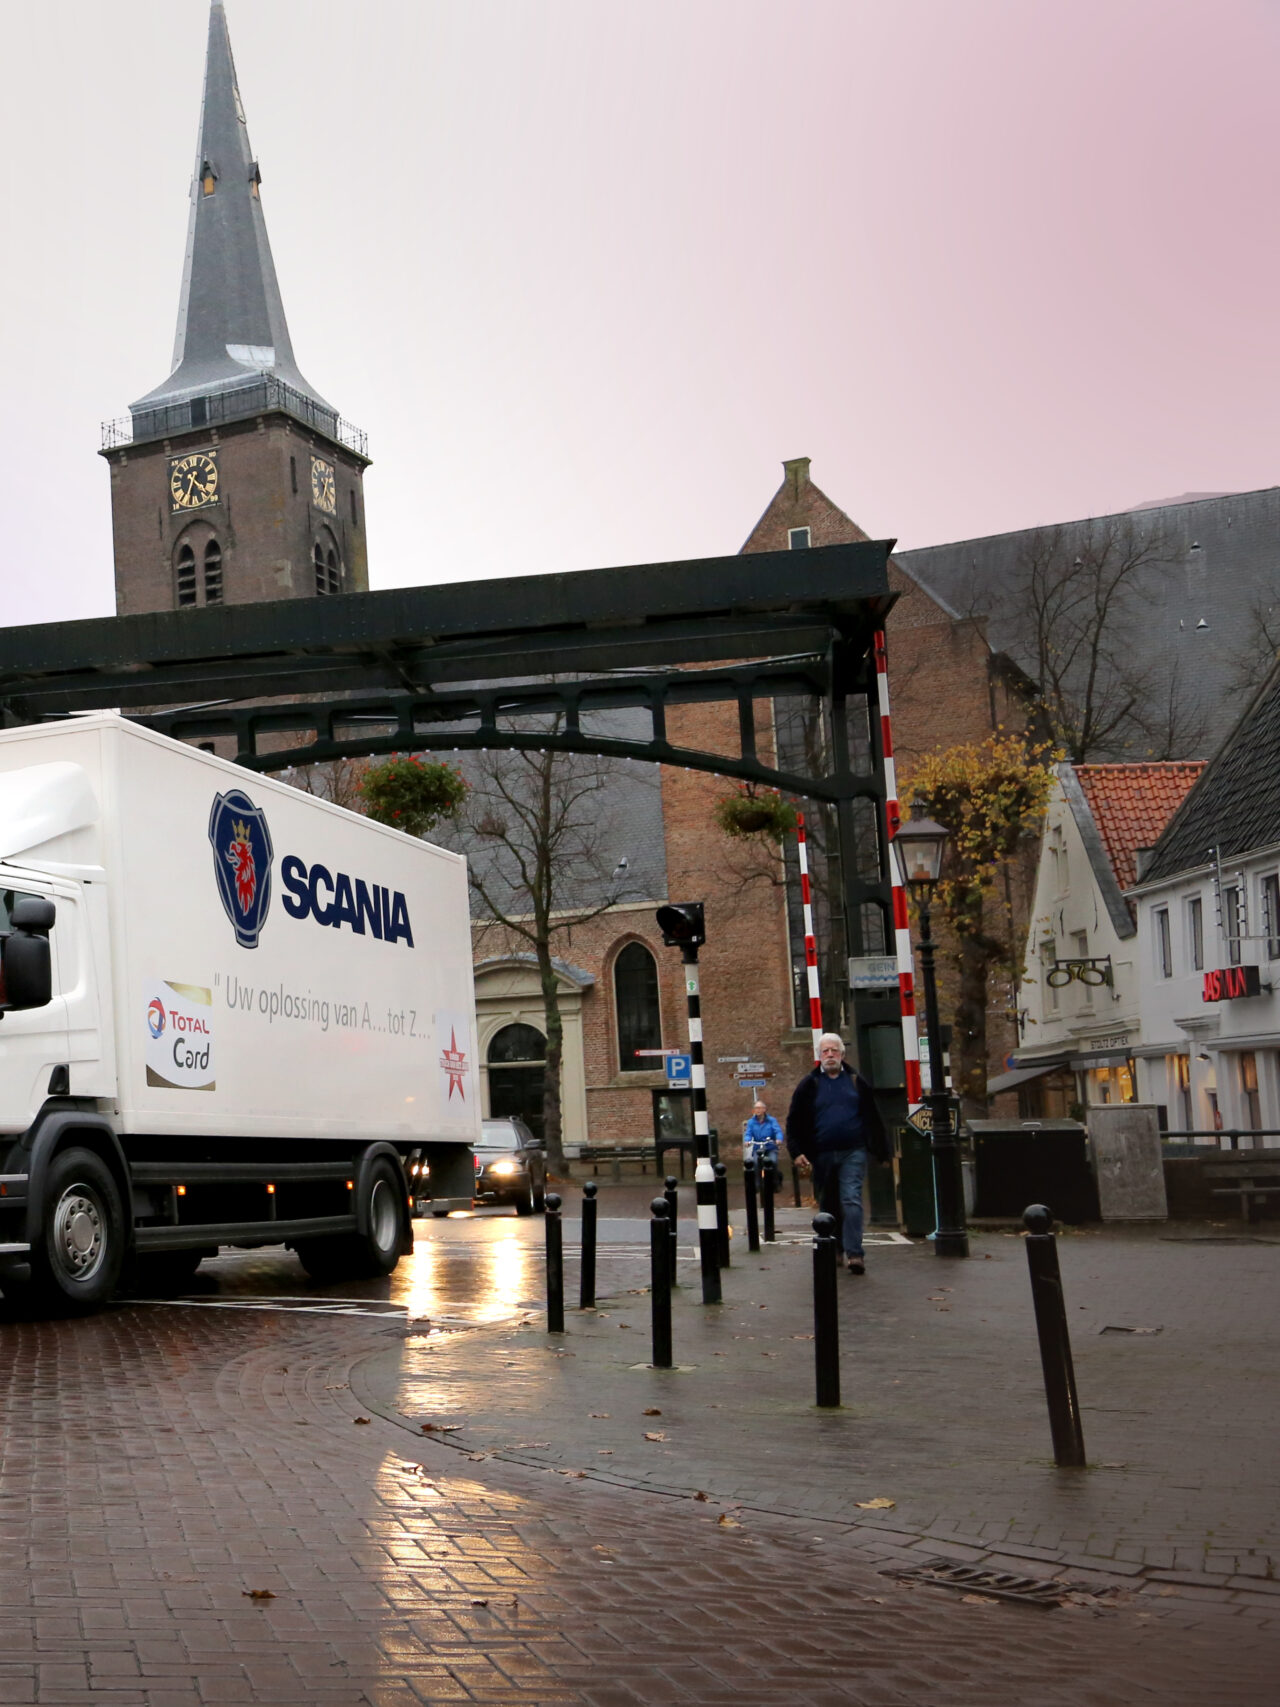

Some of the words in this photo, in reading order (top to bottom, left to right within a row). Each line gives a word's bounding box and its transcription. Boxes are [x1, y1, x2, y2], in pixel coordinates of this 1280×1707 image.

[281, 855, 415, 949] SCANIA
[259, 984, 329, 1032] oplossing
[335, 1003, 357, 1028] van
[173, 1037, 210, 1070] Card
[671, 1058, 686, 1077] P
